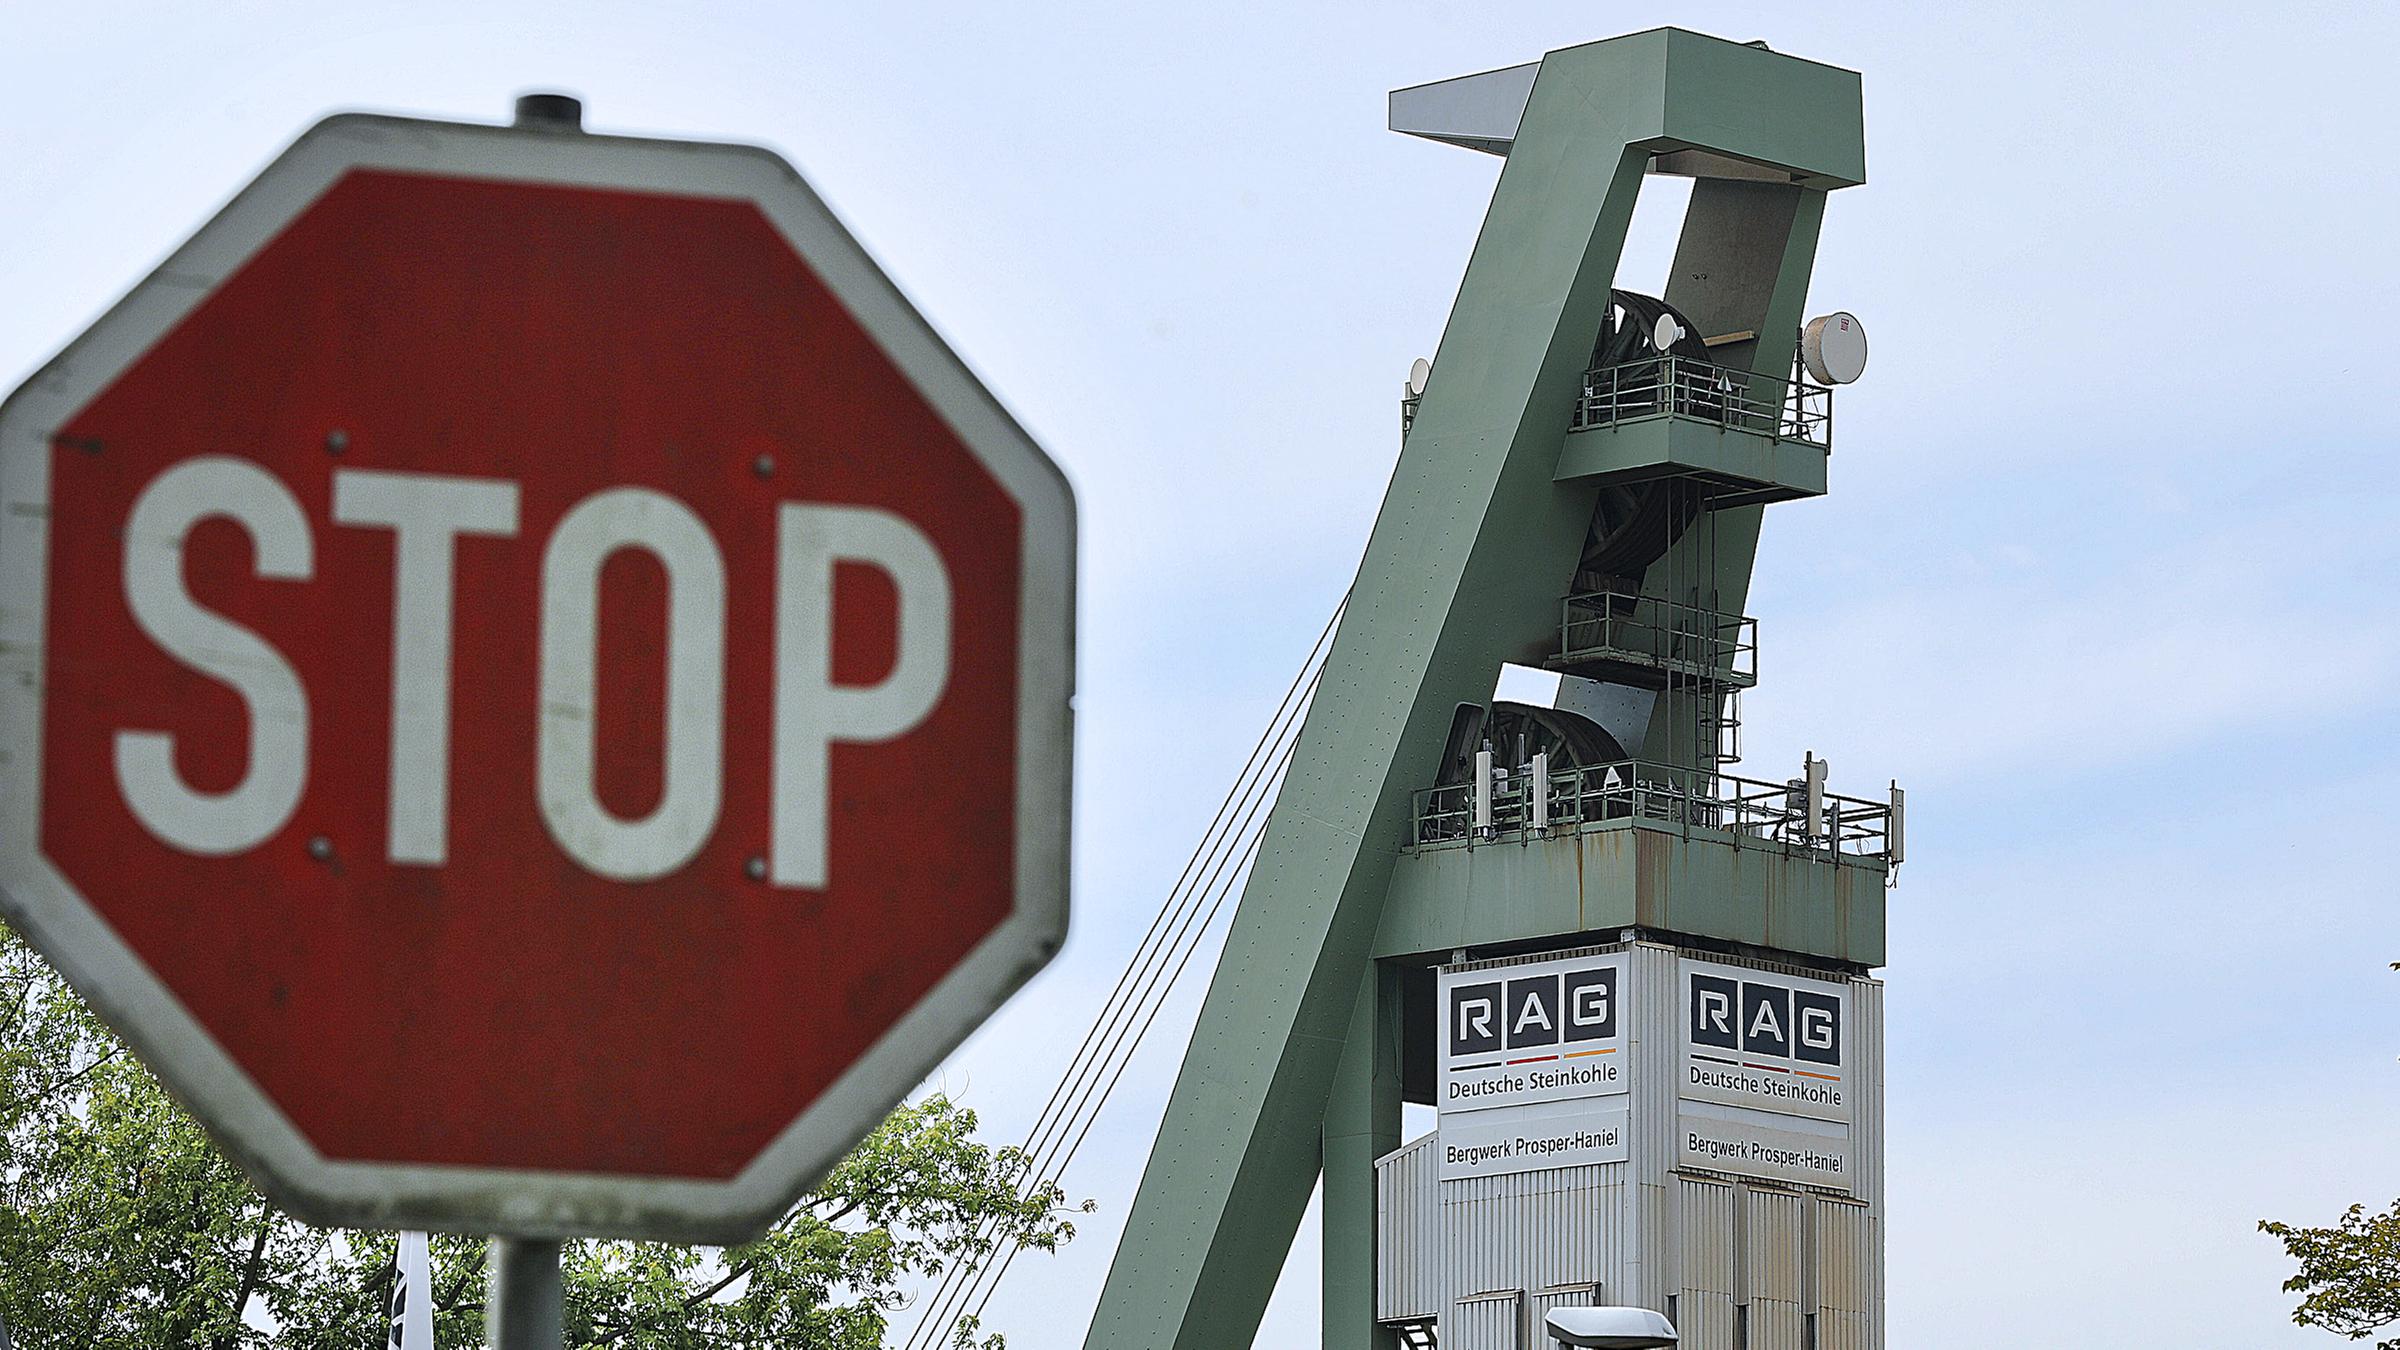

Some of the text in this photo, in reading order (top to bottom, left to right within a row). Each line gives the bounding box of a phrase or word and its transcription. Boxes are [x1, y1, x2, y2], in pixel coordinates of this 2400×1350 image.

[113, 456, 952, 890] STOP
[1459, 984, 1608, 1041] RAG
[1699, 989, 1833, 1050] RAG
[1449, 1062, 1618, 1099] Deutsche Steinkohle
[1689, 1066, 1842, 1105] Deutsche Steinkohle
[1446, 1127, 1619, 1166] Bergwerk Prosper-Haniel
[1688, 1132, 1844, 1173] Bergwerk Prosper-Haniel
